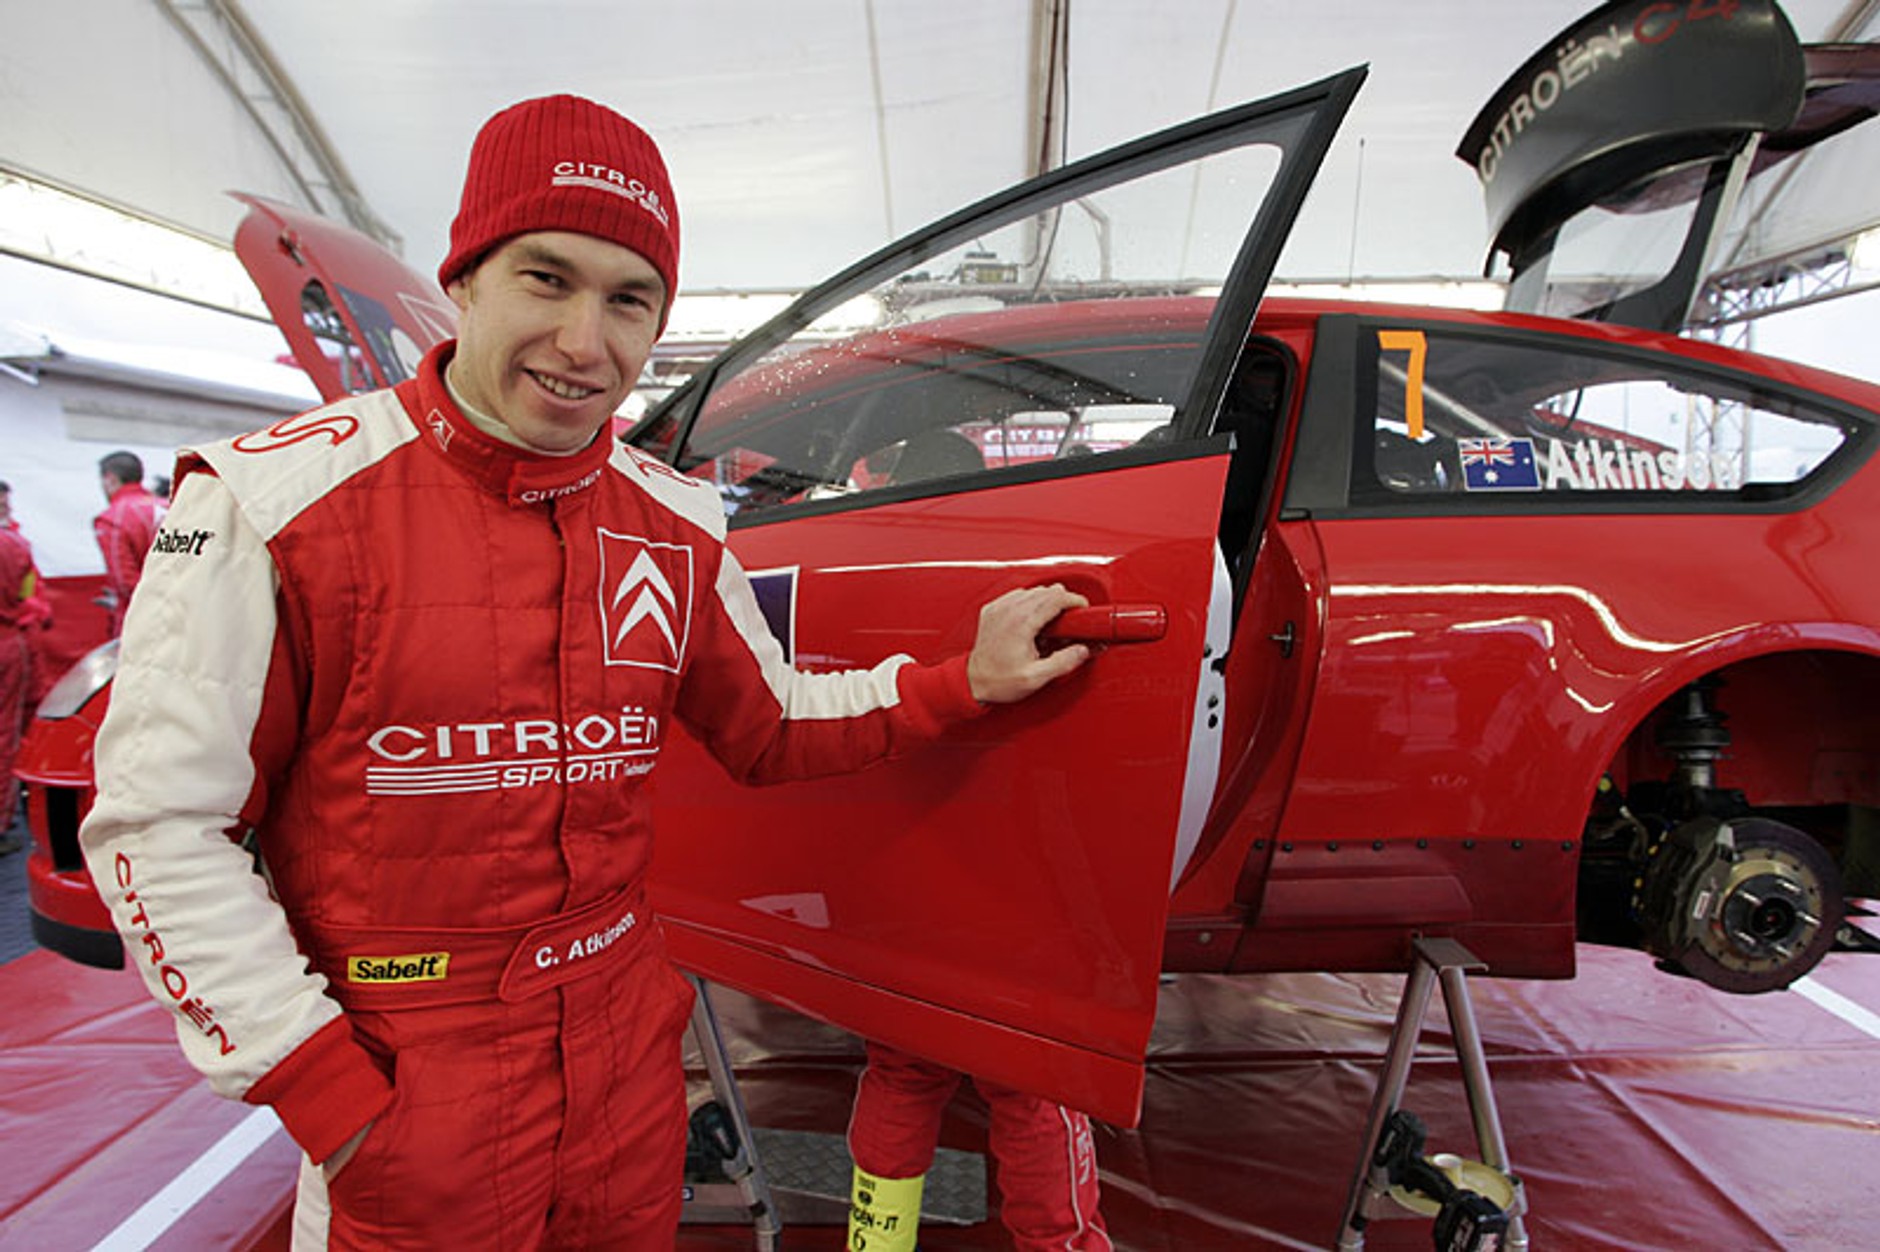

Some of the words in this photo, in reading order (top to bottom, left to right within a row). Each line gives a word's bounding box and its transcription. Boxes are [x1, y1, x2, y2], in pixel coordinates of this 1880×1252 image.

[1479, 24, 1624, 184] CITROËN
[1377, 330, 1428, 439] 7
[1545, 437, 1743, 491] Atkinson
[115, 852, 236, 1056] CITROËN
[356, 956, 438, 979] Sabelt
[535, 946, 559, 969] C.
[567, 911, 636, 961] Atkinson
